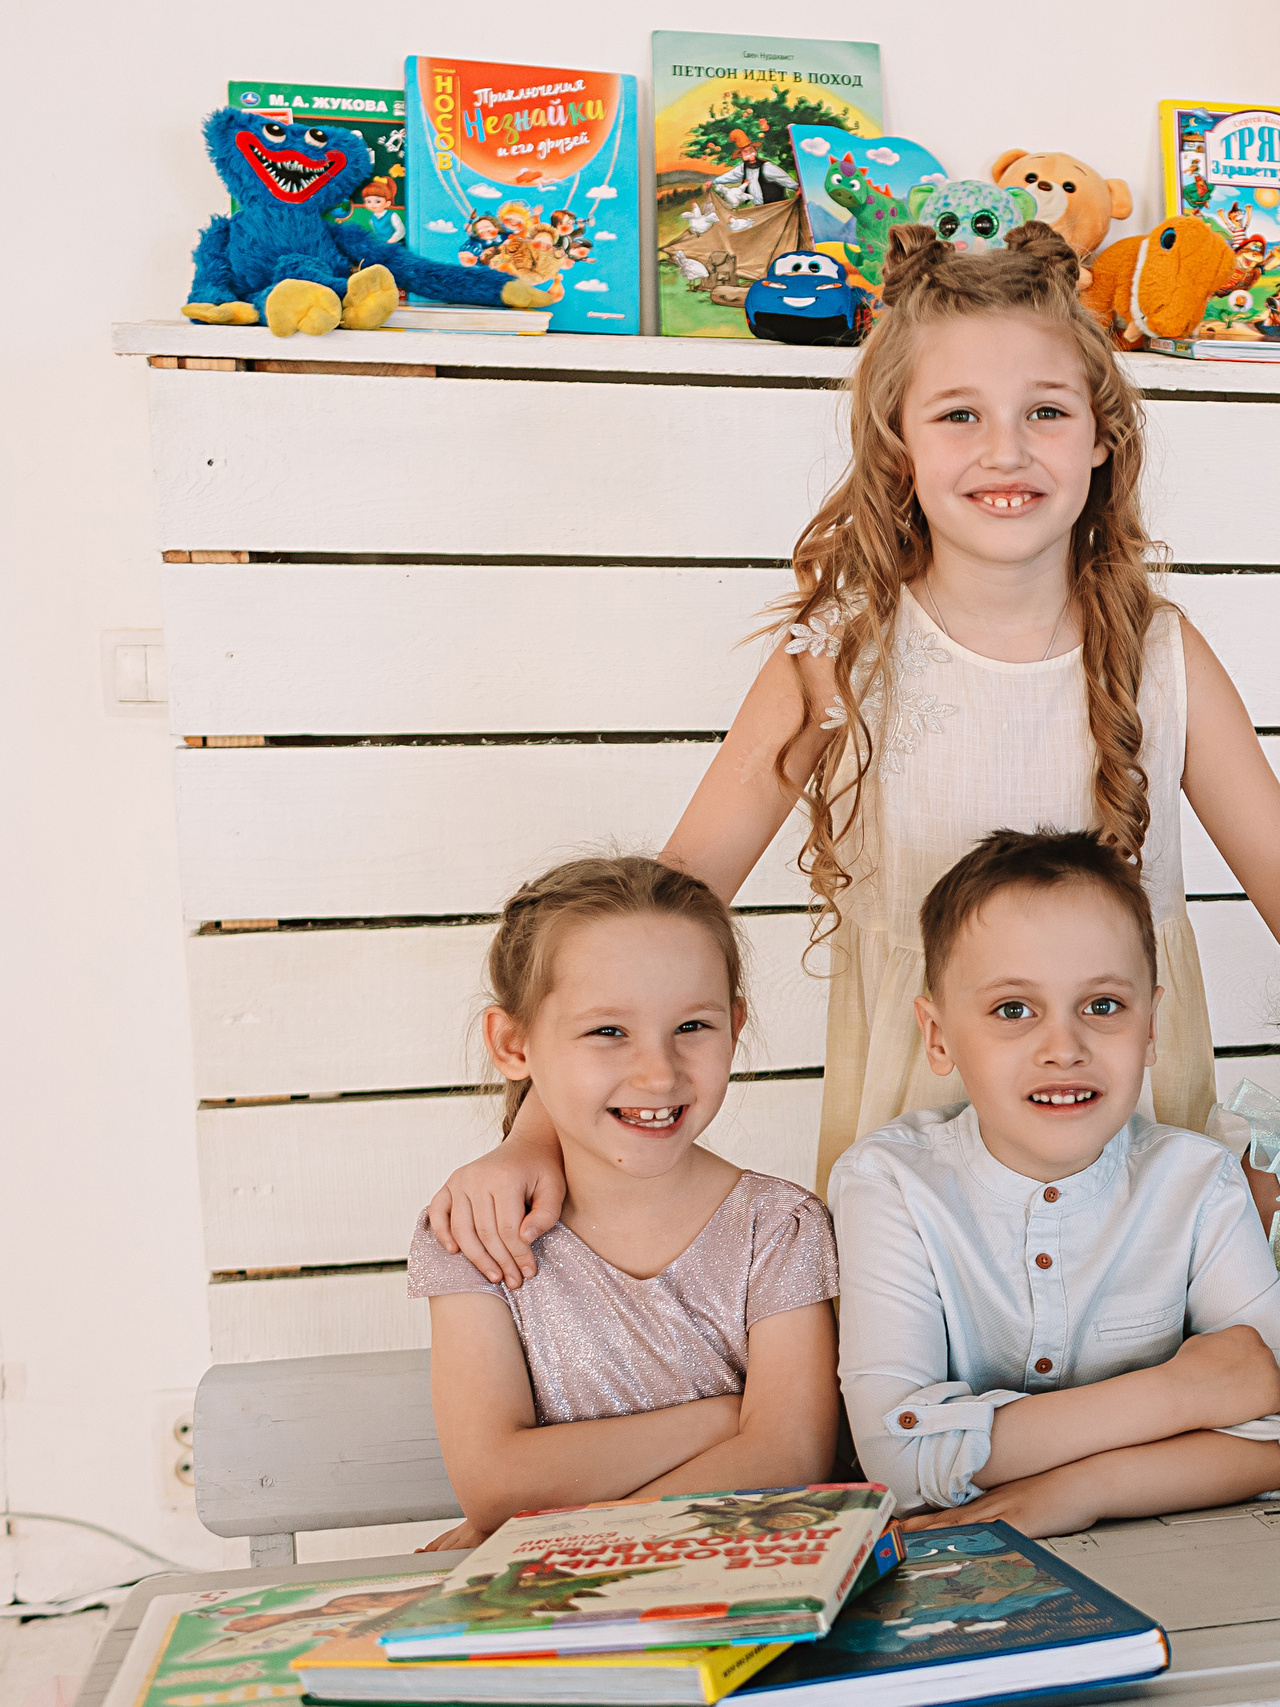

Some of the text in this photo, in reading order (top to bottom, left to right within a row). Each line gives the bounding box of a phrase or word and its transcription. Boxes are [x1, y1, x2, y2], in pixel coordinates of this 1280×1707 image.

[672, 64, 864, 88] ПЕТСОН ИДЁТ В ПОХОД
[268, 94, 290, 107] М.
[292, 95, 310, 108] А.
[312, 96, 389, 113] ЖУКОВА
[473, 79, 587, 108] Приключения
[434, 75, 455, 171] НОСОВ
[464, 98, 608, 146] Незнайки
[497, 131, 591, 160] и его друзей
[540, 1527, 843, 1561] ДИНОЗАВРЫ
[724, 1554, 822, 1571] ВСЕ
